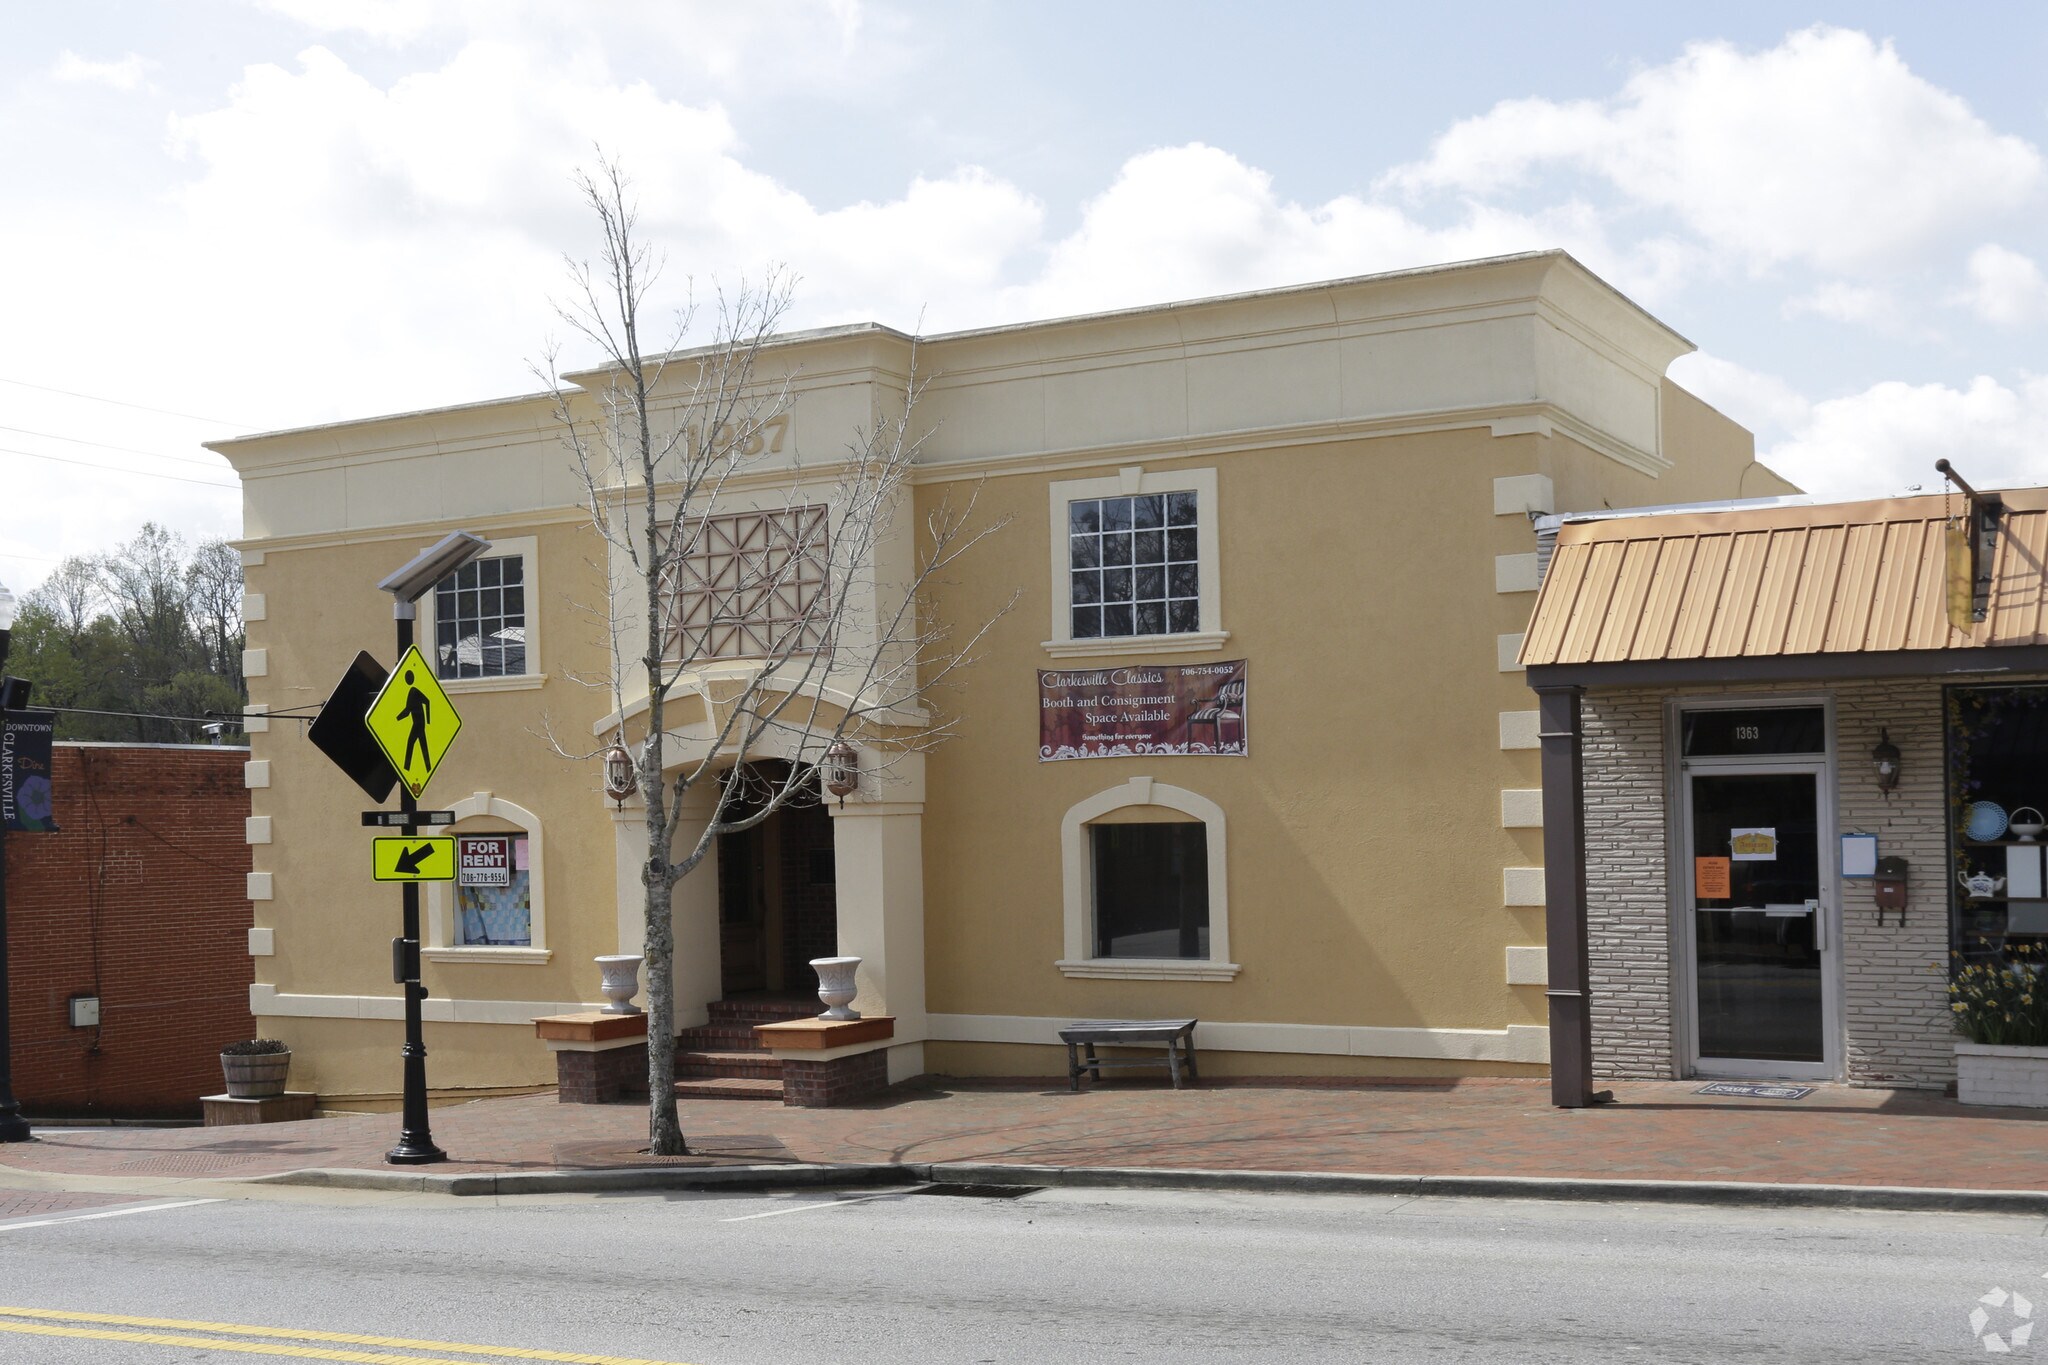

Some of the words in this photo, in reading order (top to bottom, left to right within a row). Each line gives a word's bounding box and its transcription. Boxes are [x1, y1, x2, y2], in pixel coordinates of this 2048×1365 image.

[1180, 665, 1234, 676] 706-754-0052
[1041, 671, 1109, 689] Clarkesville
[1111, 668, 1165, 686] Classics
[1042, 696, 1074, 708] Booth
[1077, 695, 1098, 707] and
[1101, 694, 1175, 709] Consignment
[1085, 712, 1118, 727] Space
[1120, 709, 1171, 723] Available
[5, 723, 53, 732] DOWNTOWN
[1736, 726, 1759, 740] 1363
[1114, 732, 1125, 740] for
[1125, 732, 1152, 741] everyone
[18, 756, 44, 770] Dine
[2, 732, 15, 820] CLARKESVILLE
[467, 841, 499, 854] FOR
[463, 855, 504, 867] RENT
